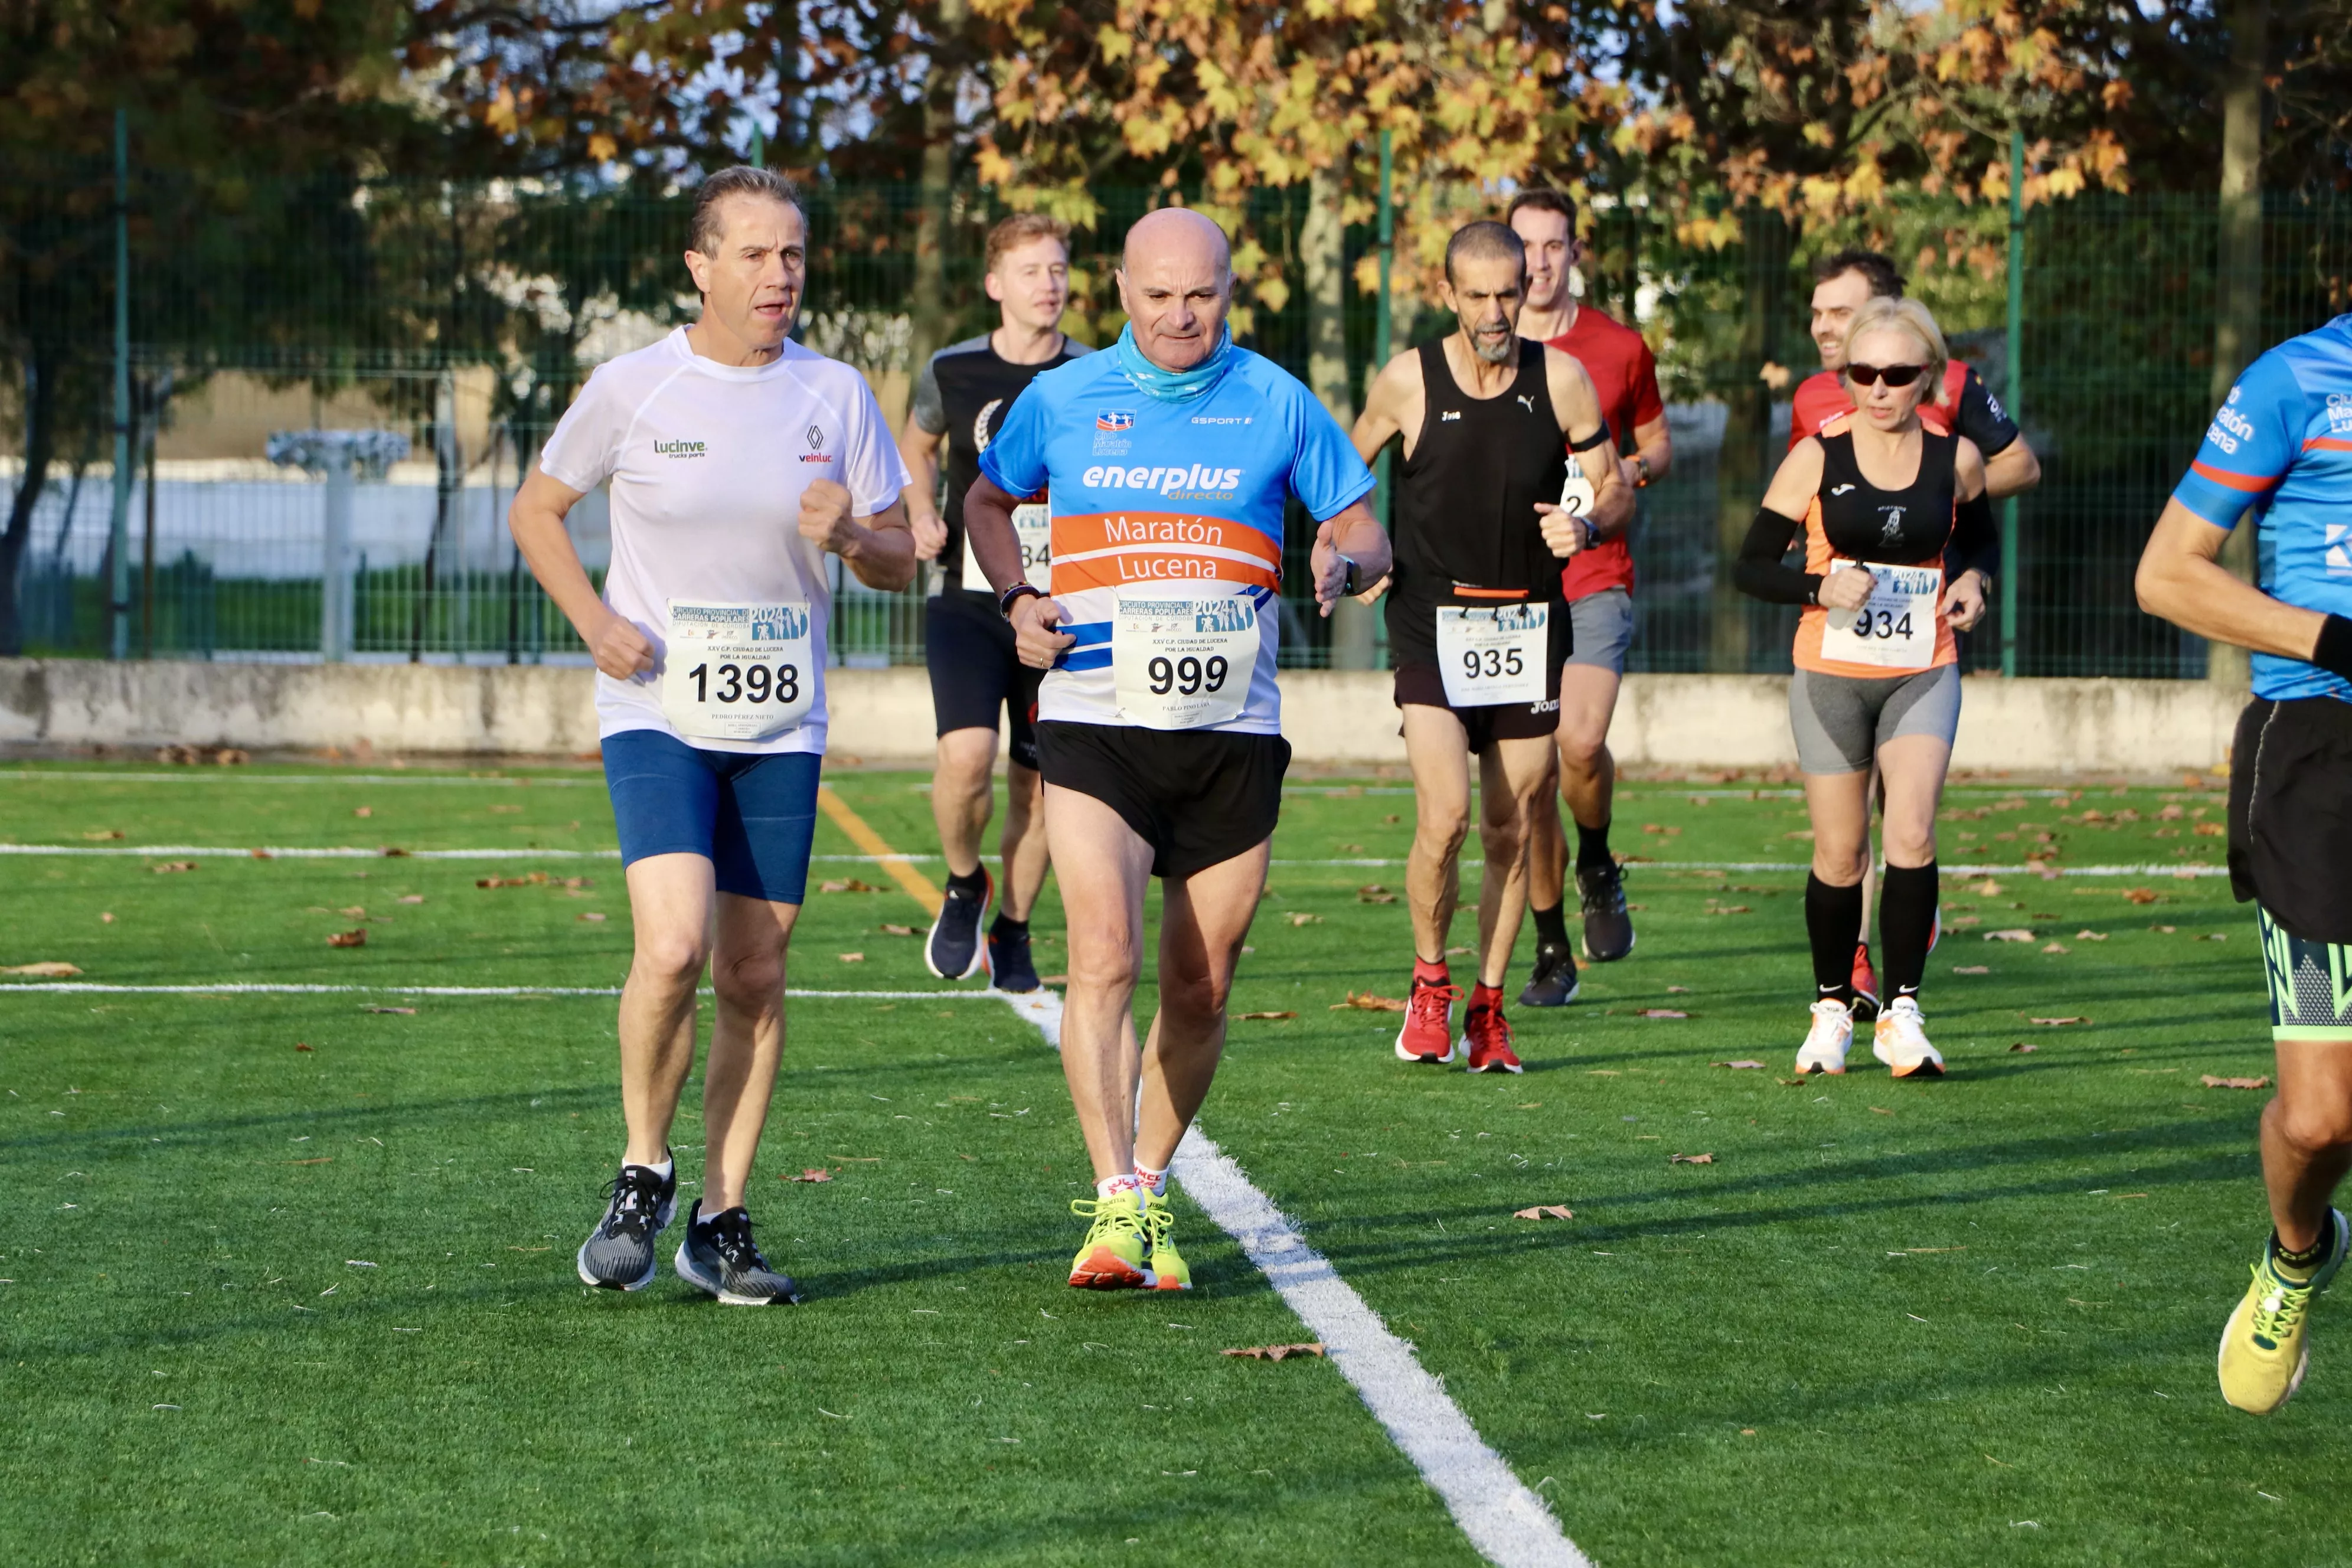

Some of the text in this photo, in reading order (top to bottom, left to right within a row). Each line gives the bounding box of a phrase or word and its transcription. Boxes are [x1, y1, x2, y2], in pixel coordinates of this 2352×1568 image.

[2325, 393, 2352, 407] Clu
[1093, 439, 1132, 448] Maratón
[1095, 432, 1117, 440] Club
[1083, 463, 1241, 495] enerplus
[1168, 489, 1233, 500] directo
[1104, 516, 1223, 545] Maratón
[1118, 556, 1216, 580] Lucena
[752, 607, 784, 623] 2024
[1195, 601, 1230, 615] 2024
[673, 613, 708, 622] CARRERAS
[1854, 609, 1913, 640] 934
[1464, 648, 1523, 679] 935
[689, 663, 799, 703] 1398
[1148, 655, 1228, 695] 999
[1530, 699, 1559, 714] Jom
